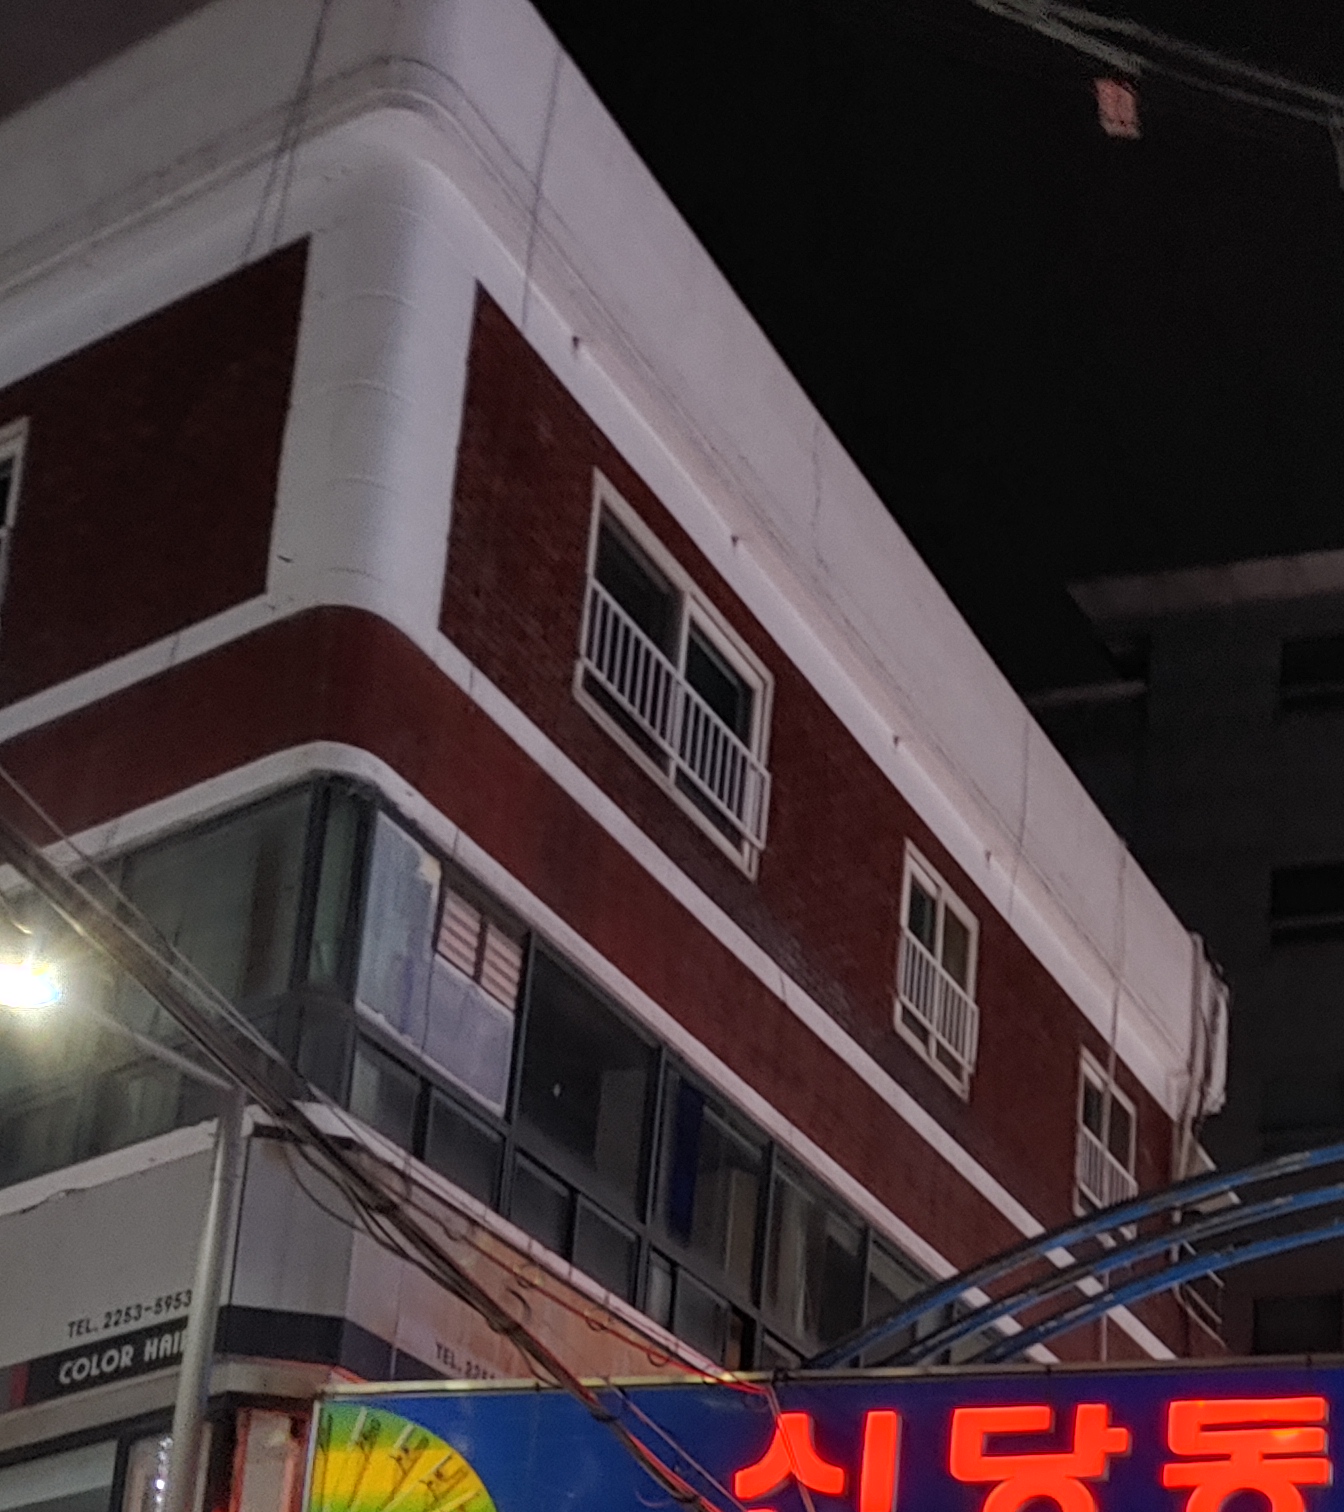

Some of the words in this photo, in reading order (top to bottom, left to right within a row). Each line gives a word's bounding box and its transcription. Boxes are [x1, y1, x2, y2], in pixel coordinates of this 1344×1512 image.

[68, 1318, 98, 1338] TEL.
[104, 1289, 193, 1329] 2253-5953
[59, 1344, 134, 1385] COLOR
[144, 1331, 183, 1362] HAI
